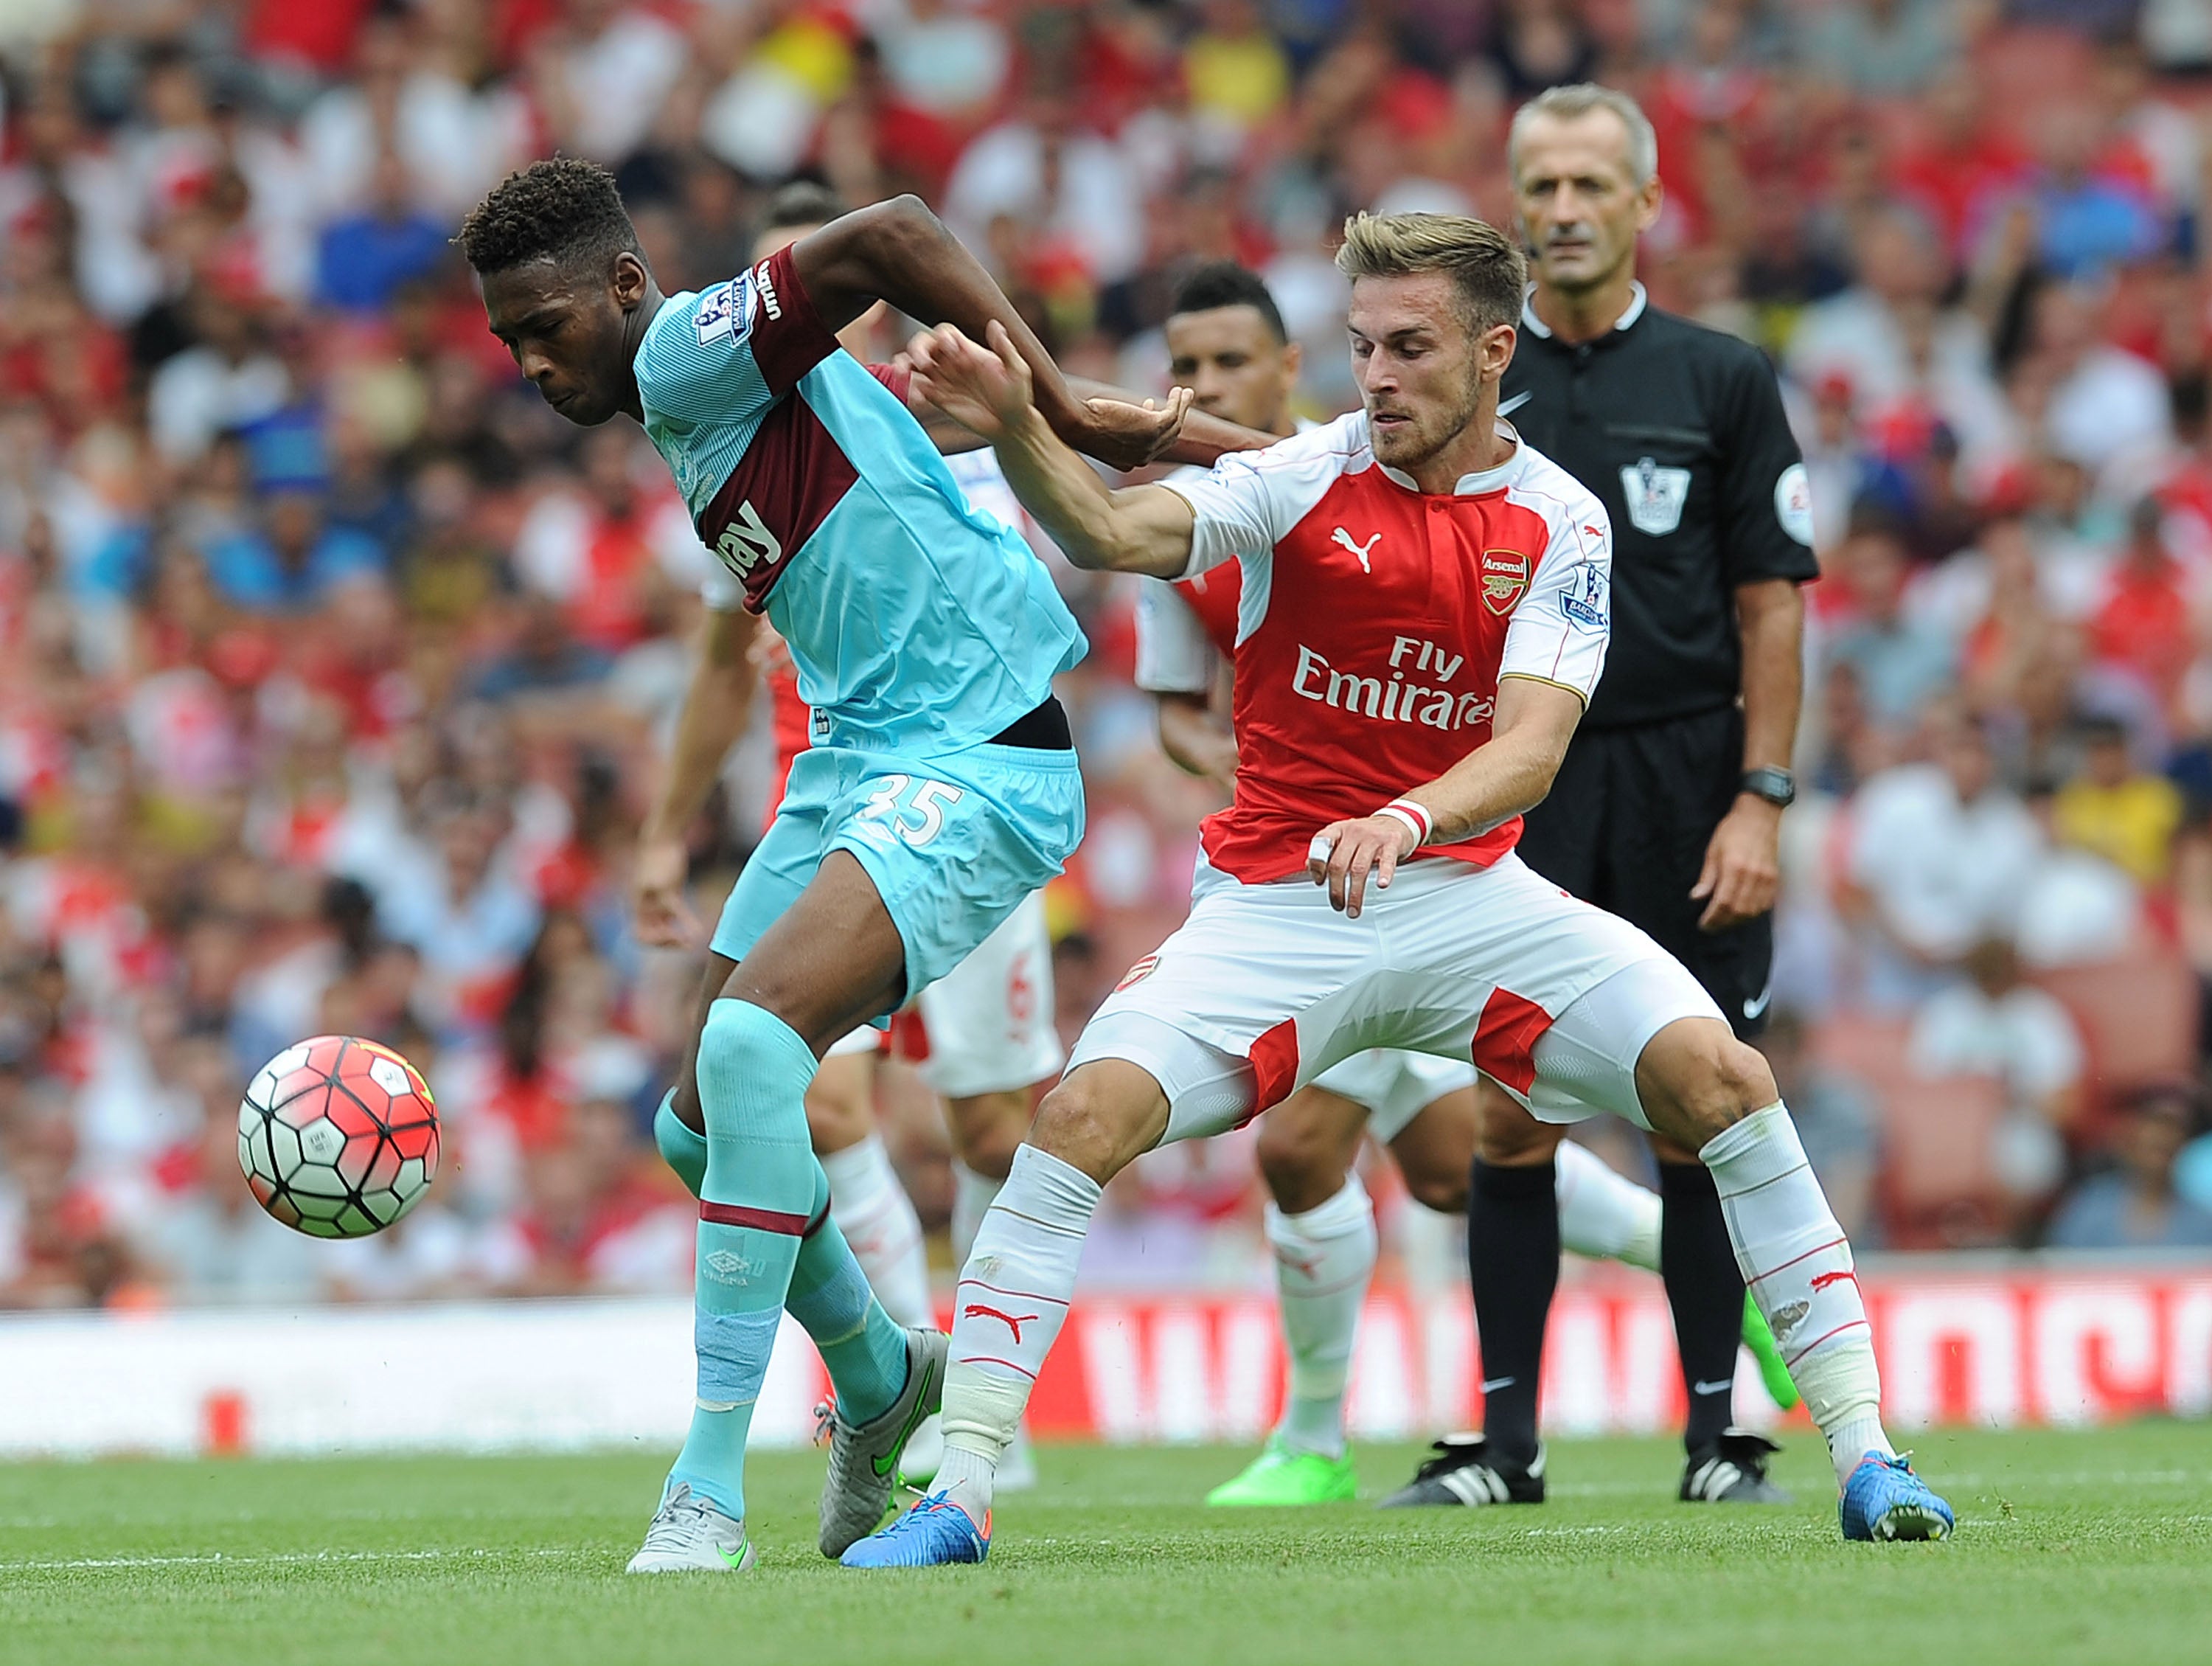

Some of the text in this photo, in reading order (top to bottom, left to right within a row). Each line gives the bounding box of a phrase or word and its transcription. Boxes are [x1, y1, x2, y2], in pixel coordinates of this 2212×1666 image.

[1483, 558, 1524, 573] Arsenal
[1388, 635, 1464, 683] Fly
[853, 774, 963, 852] 35
